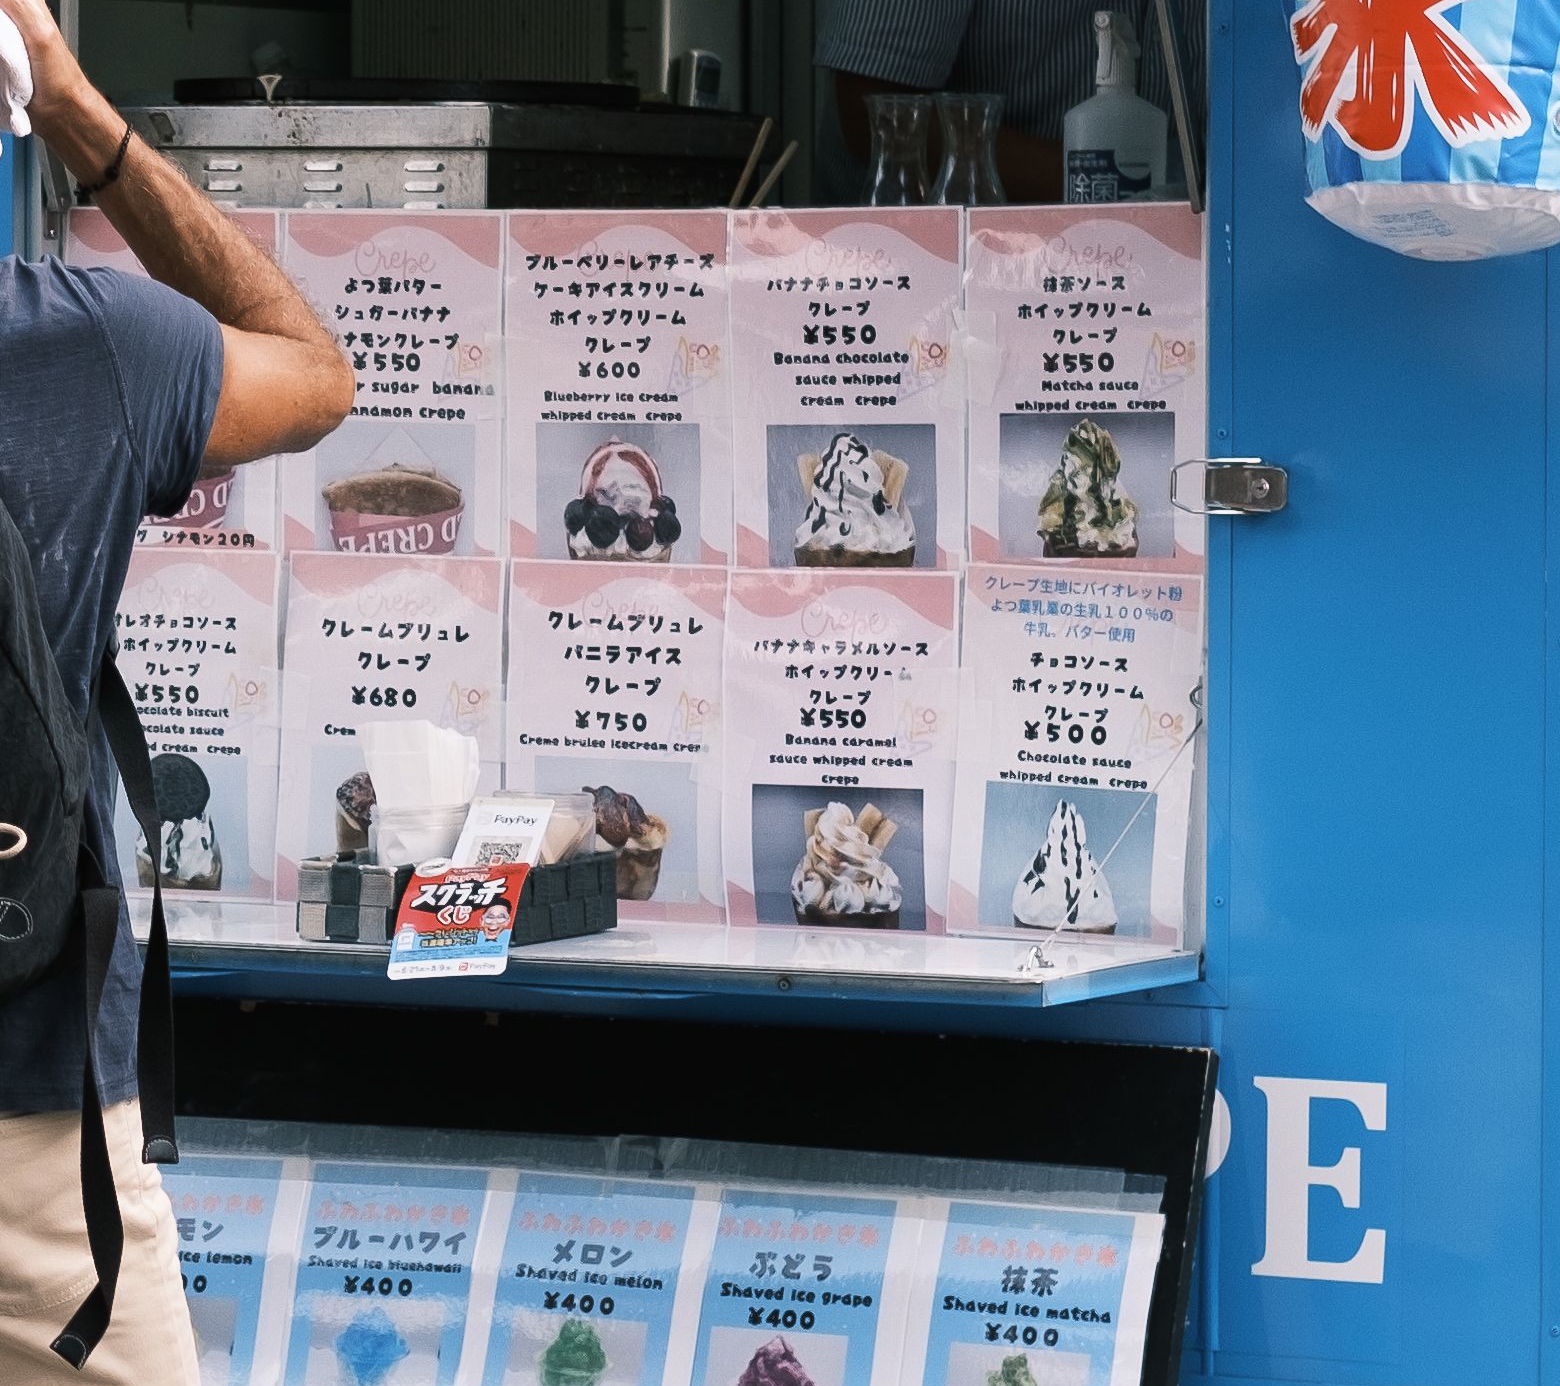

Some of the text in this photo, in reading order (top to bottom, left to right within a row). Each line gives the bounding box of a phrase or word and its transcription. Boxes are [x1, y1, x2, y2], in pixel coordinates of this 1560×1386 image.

[803, 324, 876, 345] ¥550
[353, 352, 420, 372] ¥550
[578, 361, 641, 379] ¥600
[1044, 352, 1115, 373] ¥550
[134, 684, 199, 704] ¥550
[352, 687, 417, 708] ¥680
[576, 711, 647, 733] ¥750
[800, 708, 866, 729] ¥550
[1024, 721, 1107, 745] ¥500
[494, 815, 536, 825] PayPay
[411, 878, 507, 908] スクラッチ
[438, 906, 472, 924] くじ
[175, 1218, 225, 1242] モン
[343, 1275, 413, 1297] ¥400
[544, 1291, 615, 1316] ¥400
[749, 1307, 815, 1331] ¥400
[985, 1322, 1059, 1348] ¥400
